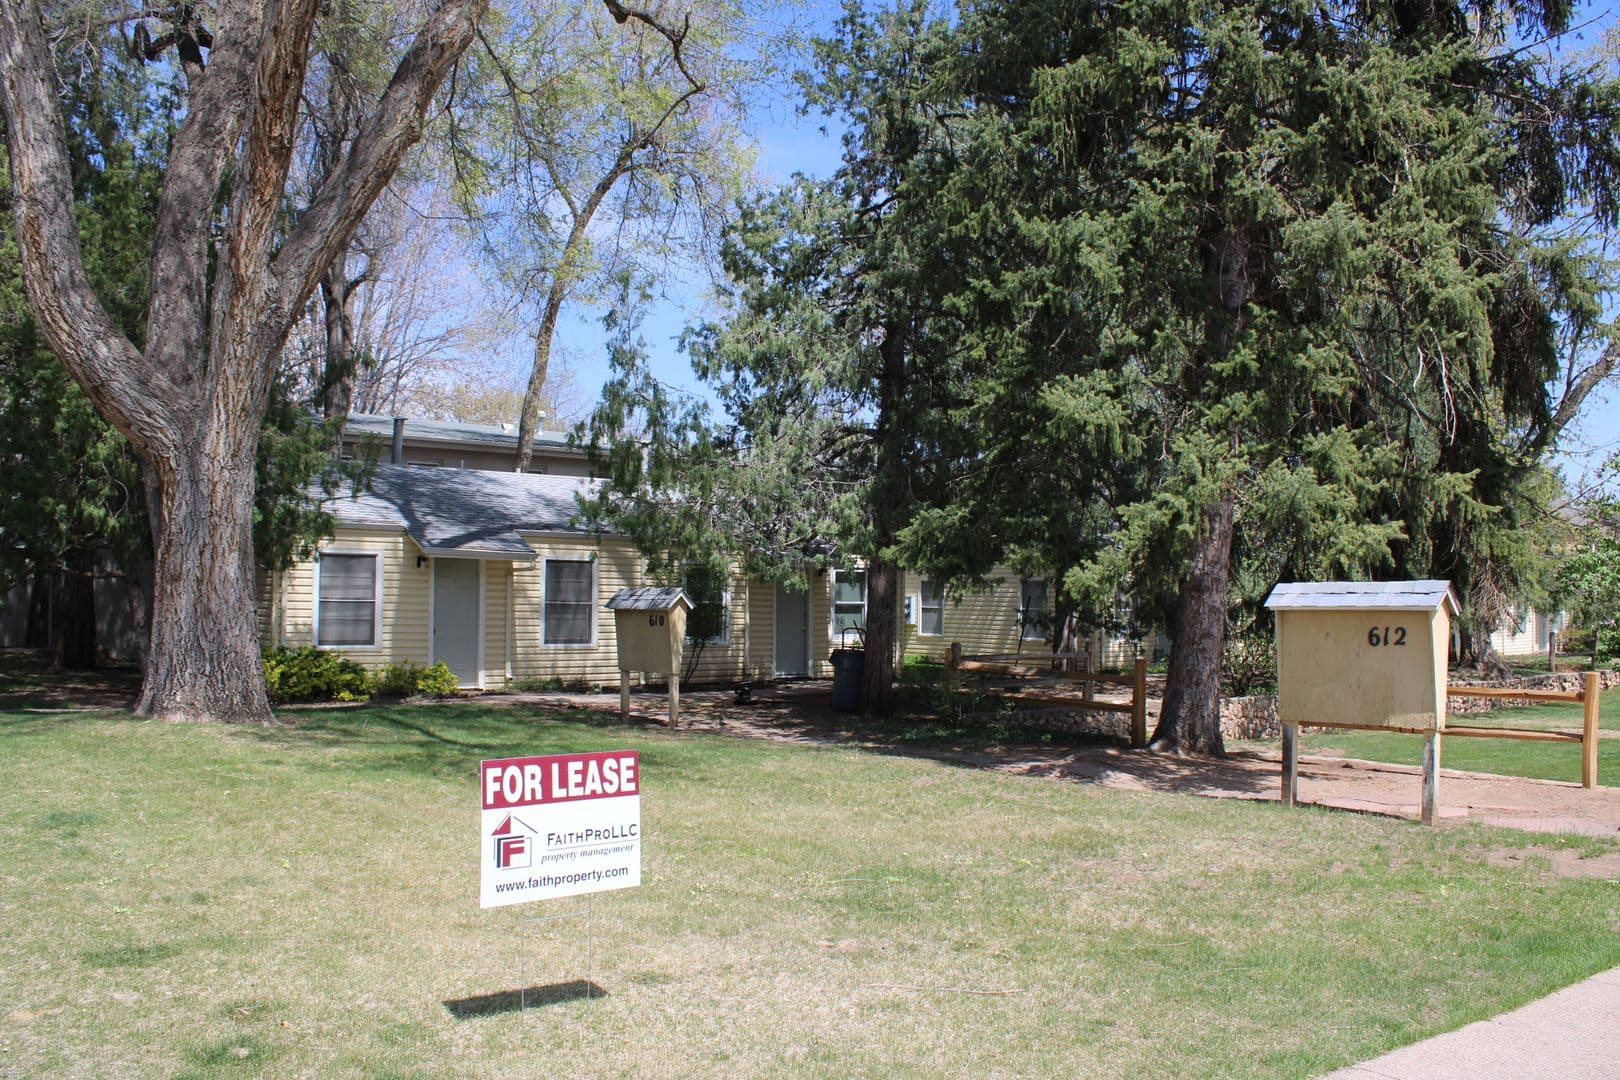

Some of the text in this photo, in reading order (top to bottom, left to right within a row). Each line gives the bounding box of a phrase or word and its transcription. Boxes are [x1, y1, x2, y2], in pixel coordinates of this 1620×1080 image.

[649, 615, 664, 626] 610
[1368, 626, 1406, 646] 612
[486, 757, 636, 805] FOR LEASE
[541, 844, 634, 865] property management
[496, 866, 629, 893] www.faithproperty.com
